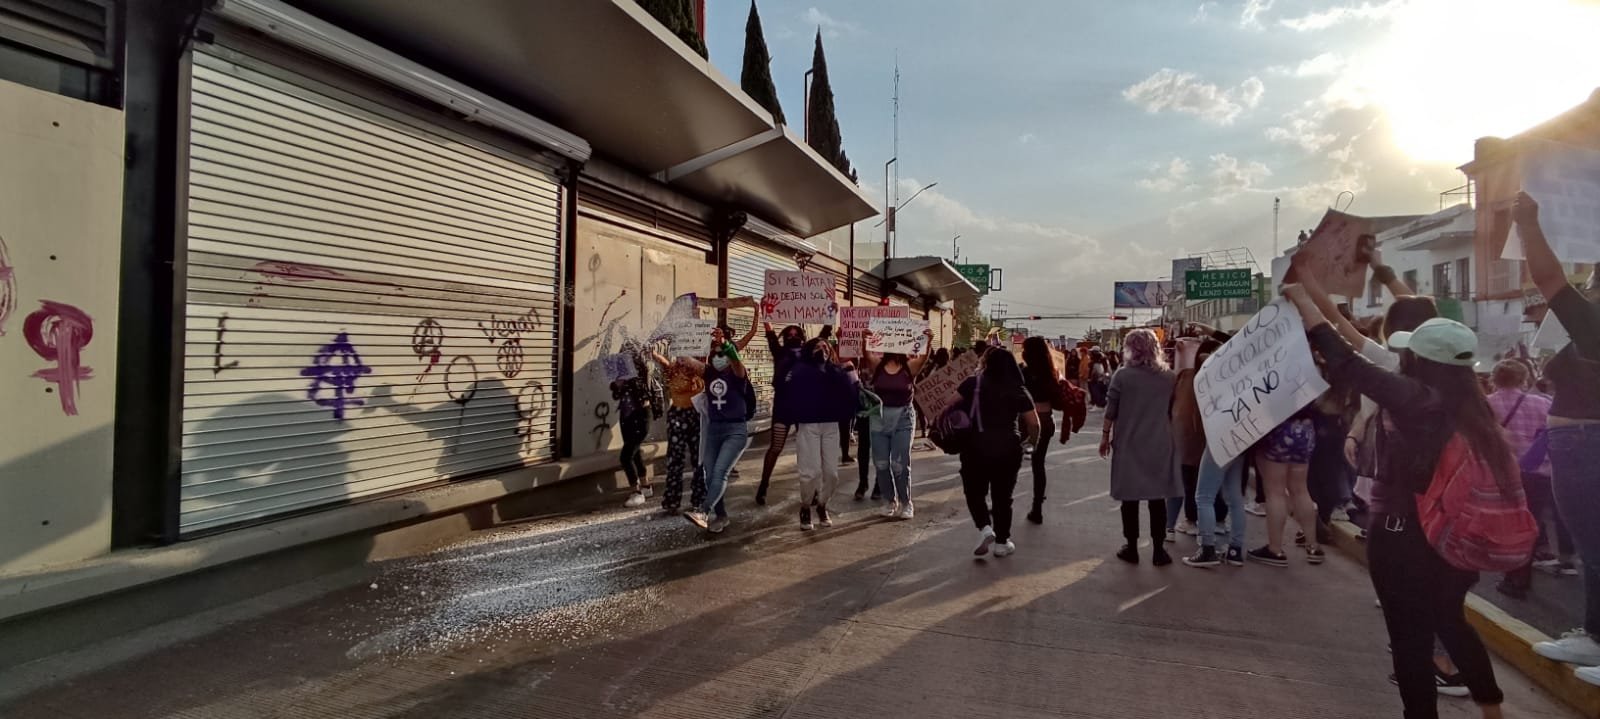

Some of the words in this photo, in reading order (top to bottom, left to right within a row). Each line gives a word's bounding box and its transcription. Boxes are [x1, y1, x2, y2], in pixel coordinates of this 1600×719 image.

[768, 273, 781, 286] SI
[786, 276, 799, 287] ME
[801, 274, 836, 288] MATAN
[1202, 272, 1247, 280] MEXICO
[780, 292, 807, 301] DEJEN
[1223, 289, 1250, 297] CHARRO
[776, 308, 791, 319] MI
[919, 374, 942, 393] FELIZ
[1222, 397, 1251, 423] YA
[1252, 370, 1280, 404] NO
